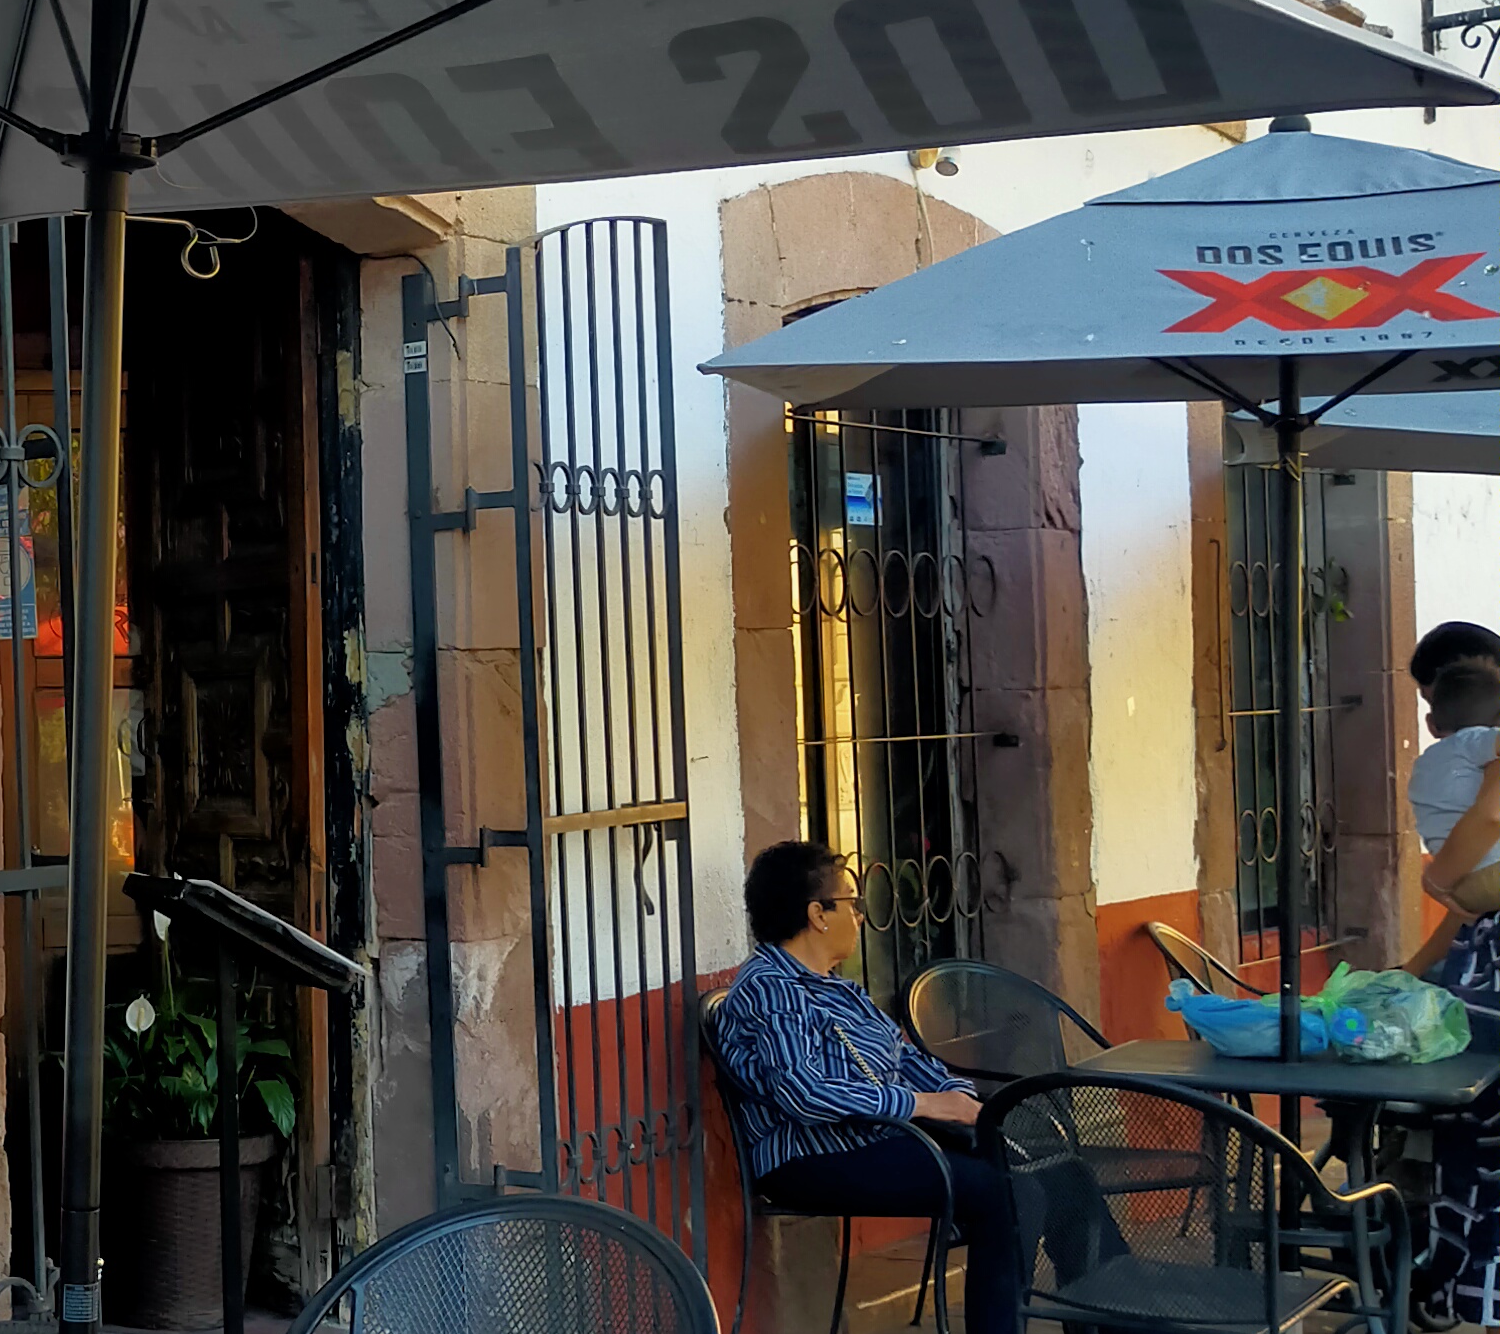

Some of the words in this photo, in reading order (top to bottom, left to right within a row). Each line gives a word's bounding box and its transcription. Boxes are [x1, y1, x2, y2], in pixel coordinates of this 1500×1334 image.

[1268, 228, 1356, 240] CERVEZA
[1195, 244, 1284, 266] DOS
[1155, 252, 1500, 334] XX
